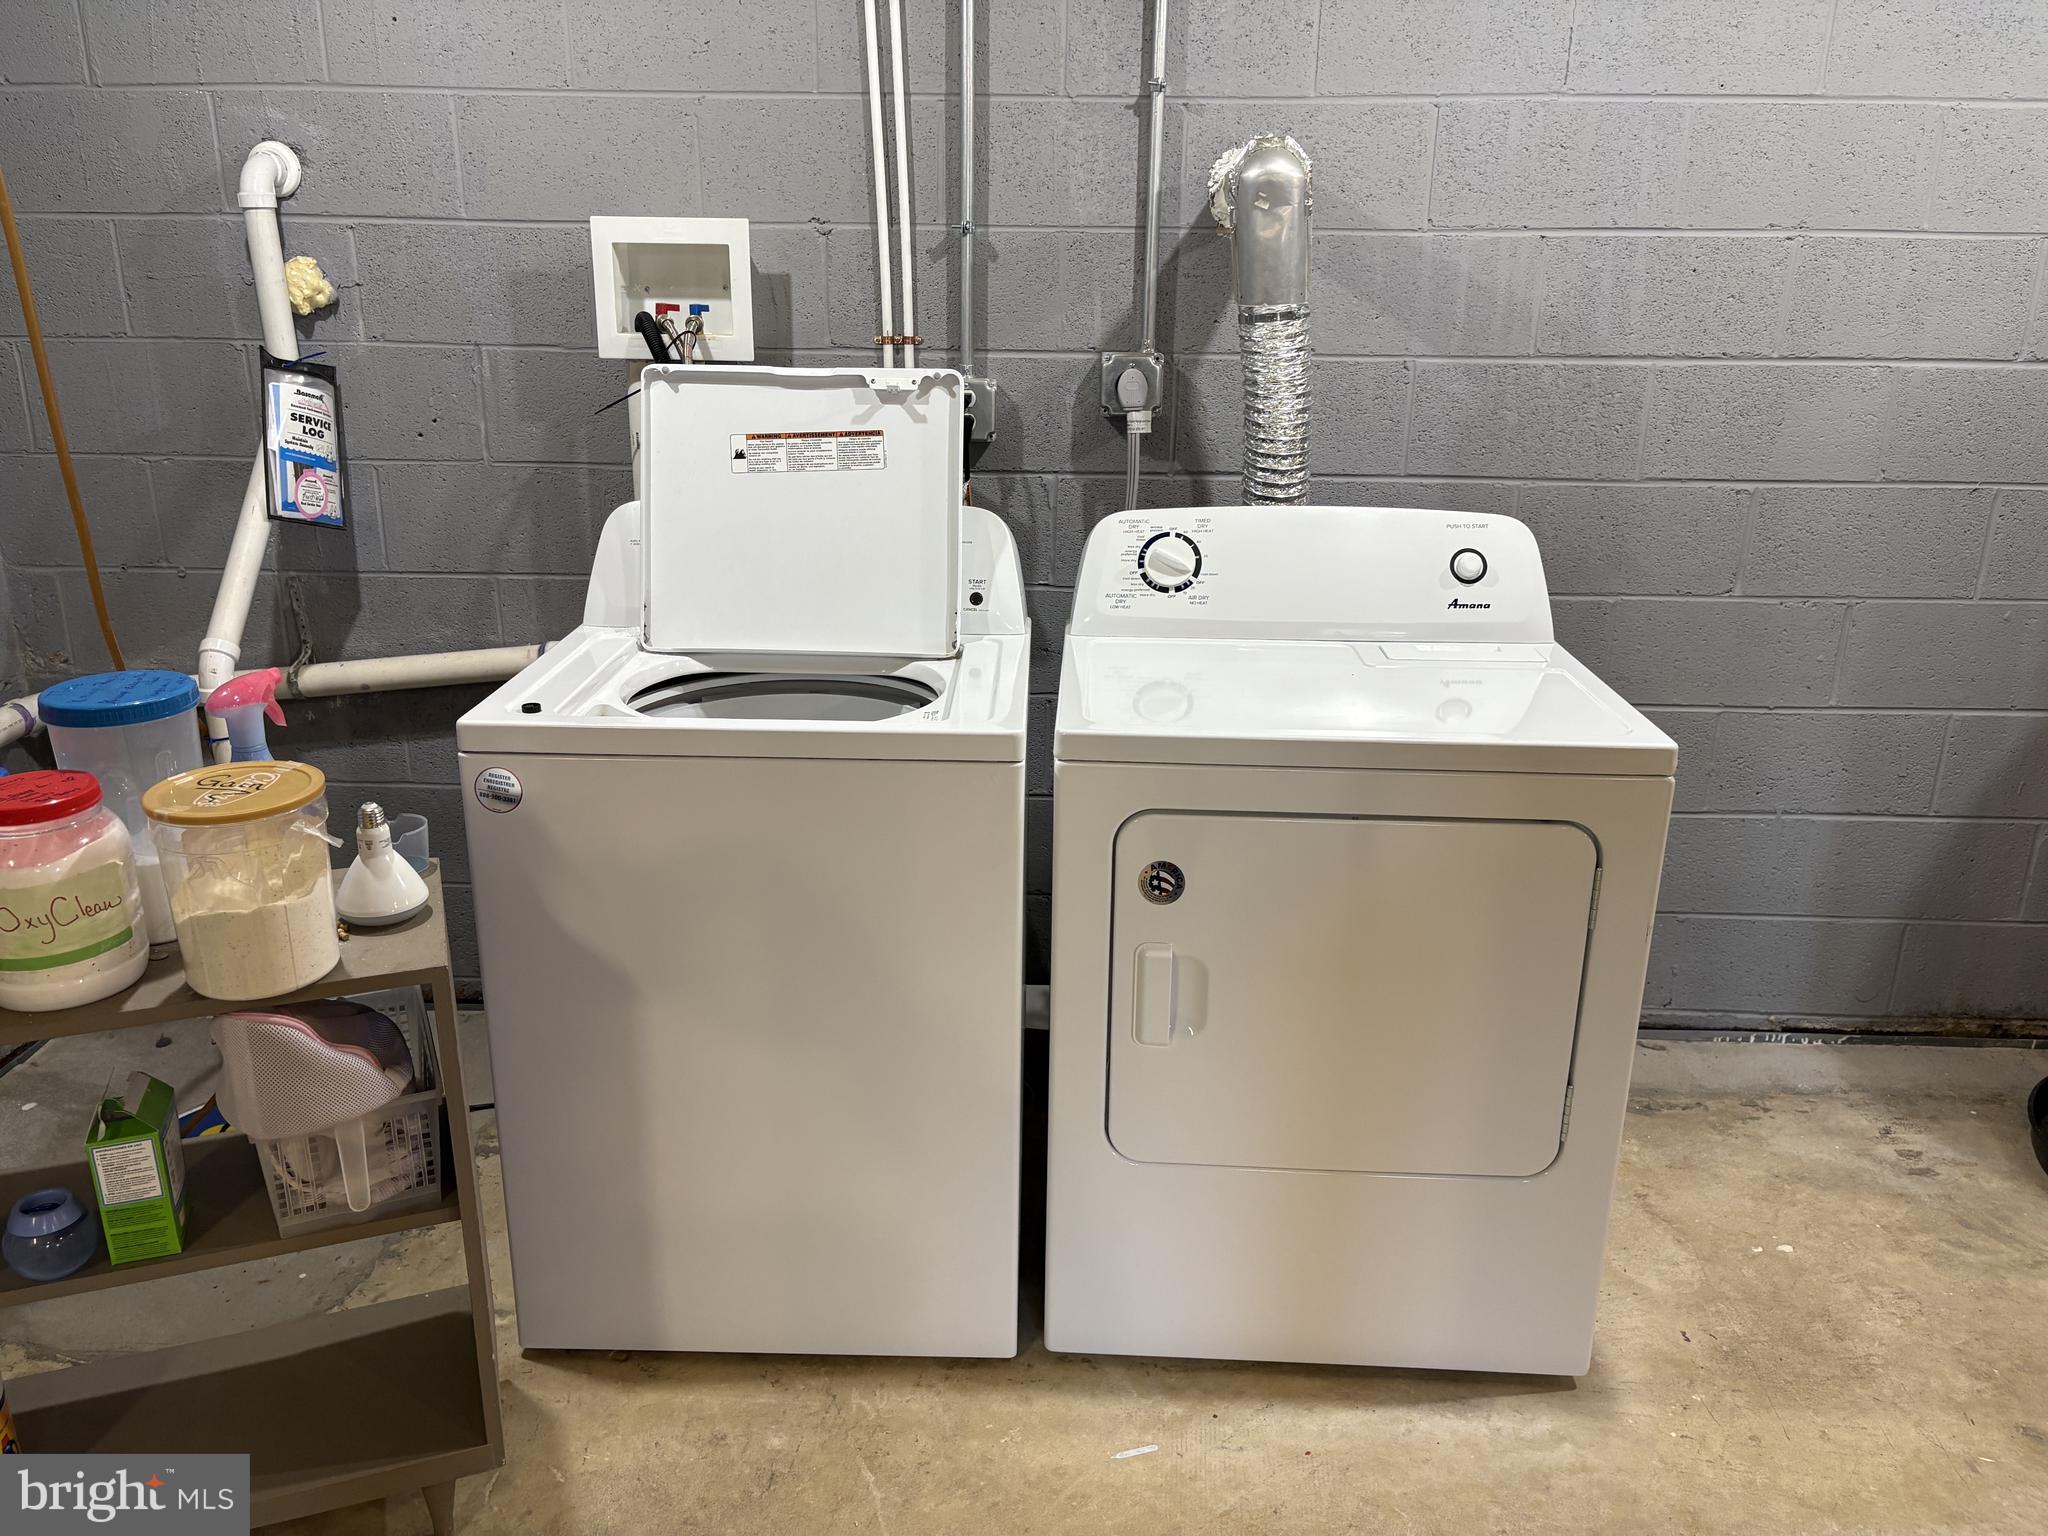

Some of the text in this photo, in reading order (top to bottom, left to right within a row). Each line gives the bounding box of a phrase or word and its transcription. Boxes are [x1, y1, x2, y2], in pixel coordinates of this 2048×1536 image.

[290, 412, 331, 431] SERVICE
[302, 426, 325, 439] LOG
[1447, 598, 1491, 610] Amana
[488, 772, 511, 781] REGISTER
[0, 896, 122, 945] OxyClean
